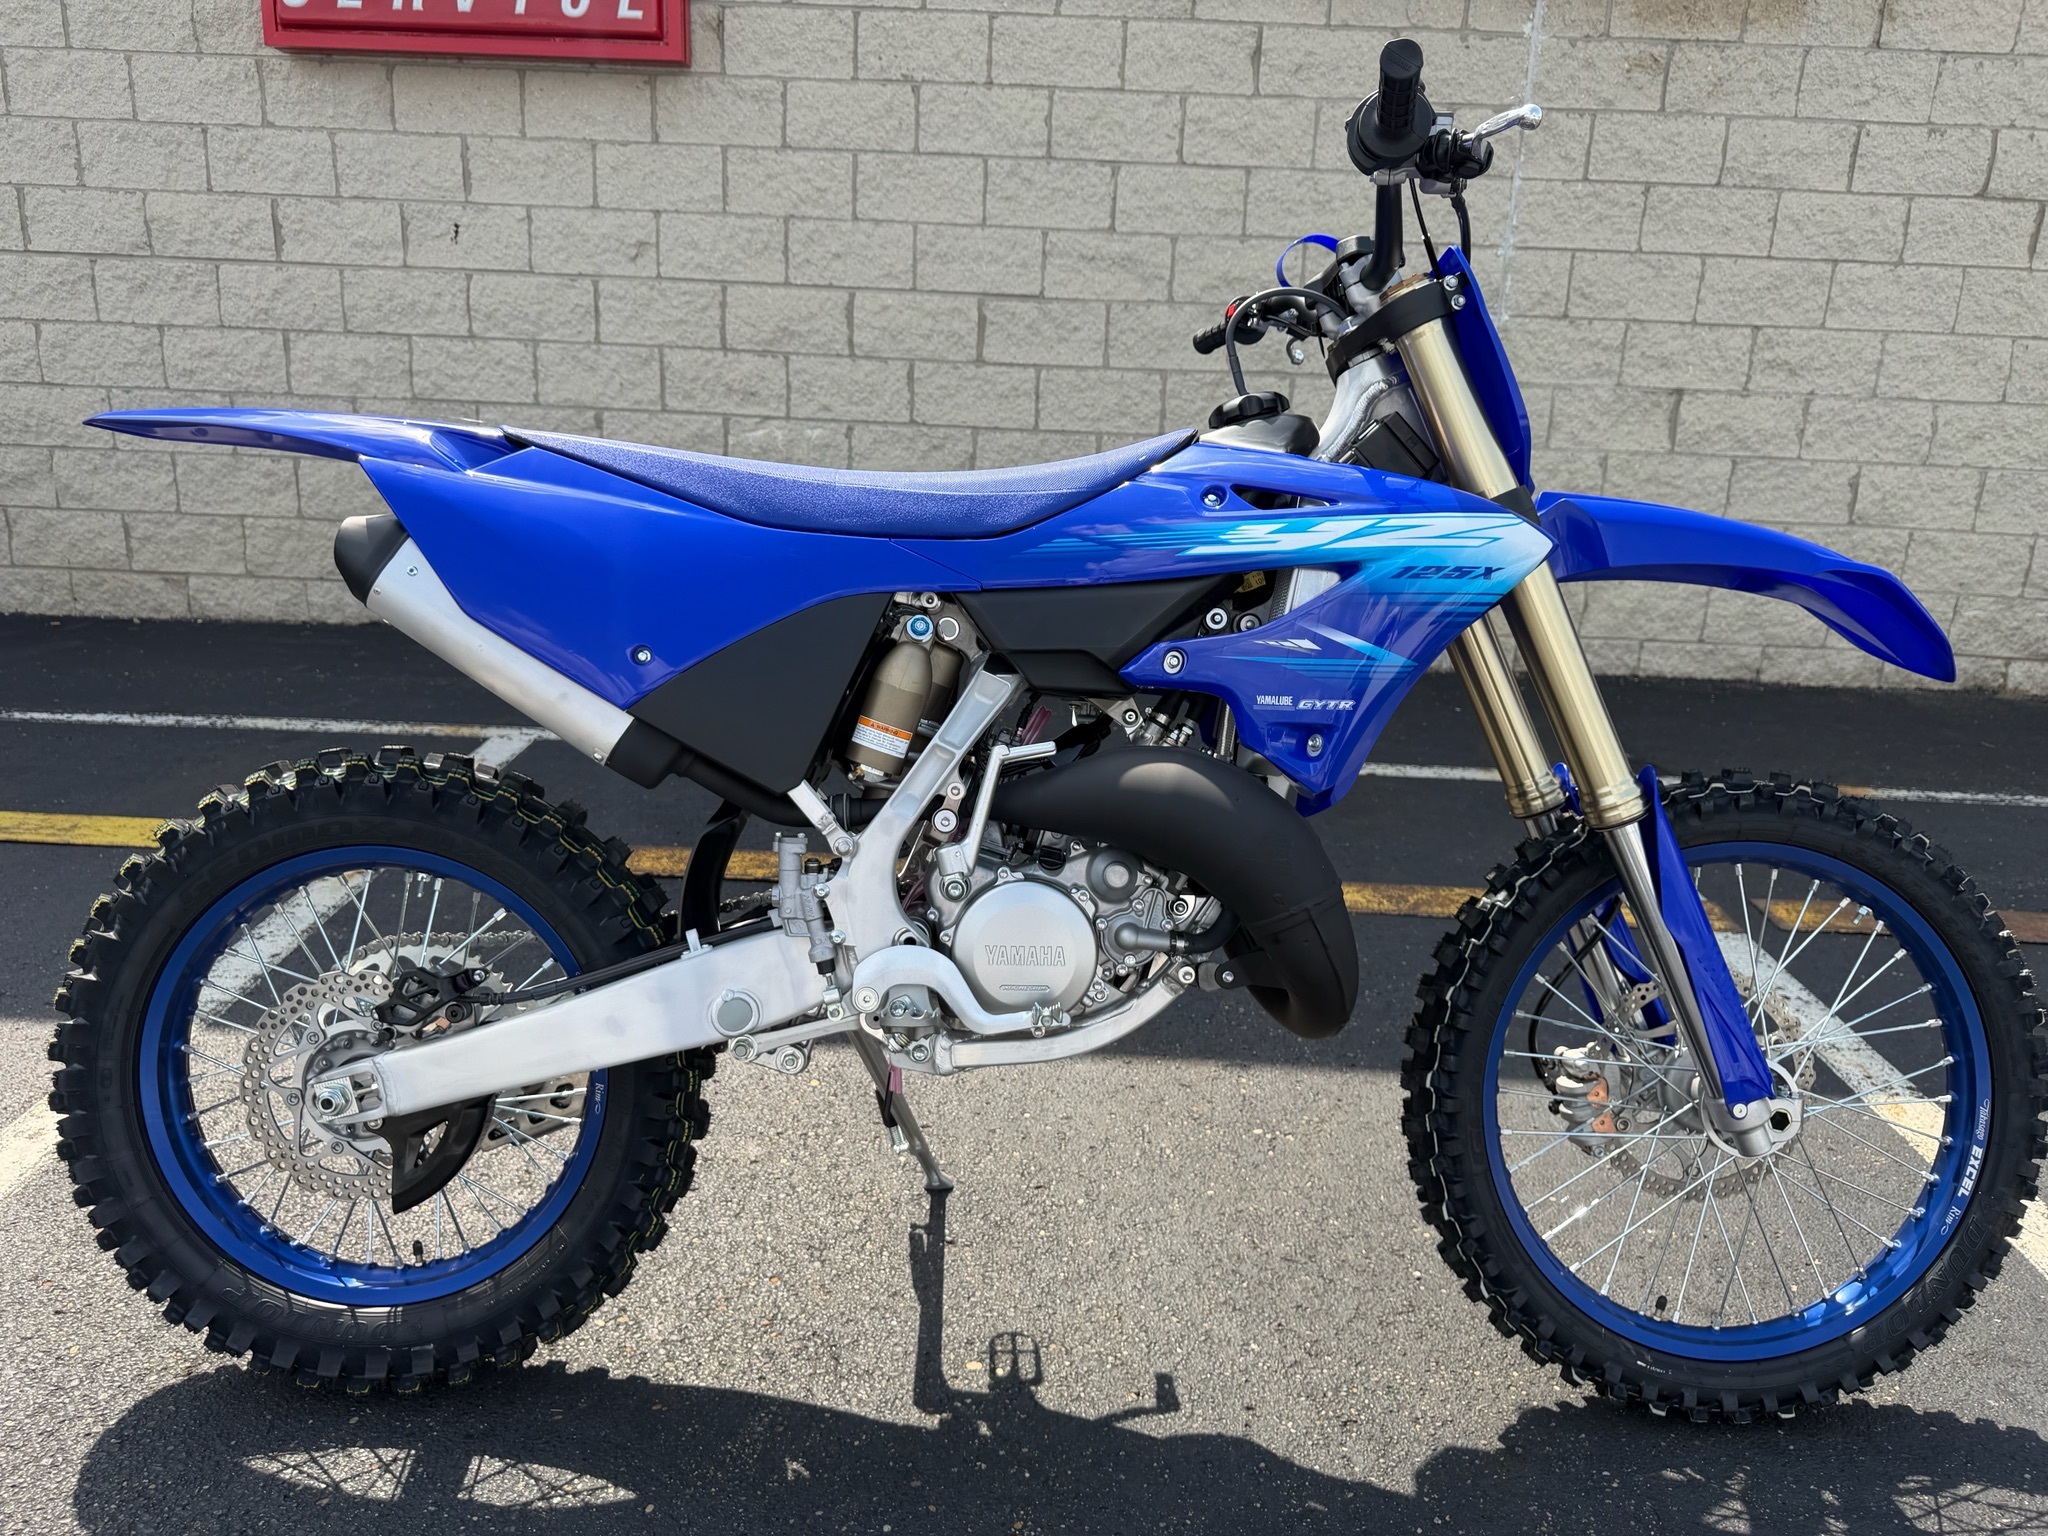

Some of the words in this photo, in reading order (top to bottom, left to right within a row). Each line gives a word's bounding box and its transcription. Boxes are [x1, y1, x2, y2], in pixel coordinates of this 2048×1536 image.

[1388, 565, 1506, 580] 125X
[1256, 694, 1294, 706] YAMALUBE
[1296, 698, 1357, 711] GYTR
[984, 944, 1066, 967] YAMAHA
[1957, 1144, 1984, 1198] EXCEL
[1940, 1205, 1962, 1236] Rim
[1861, 1214, 1991, 1355] DUNLOP
[219, 1285, 409, 1342] DUNLOP
